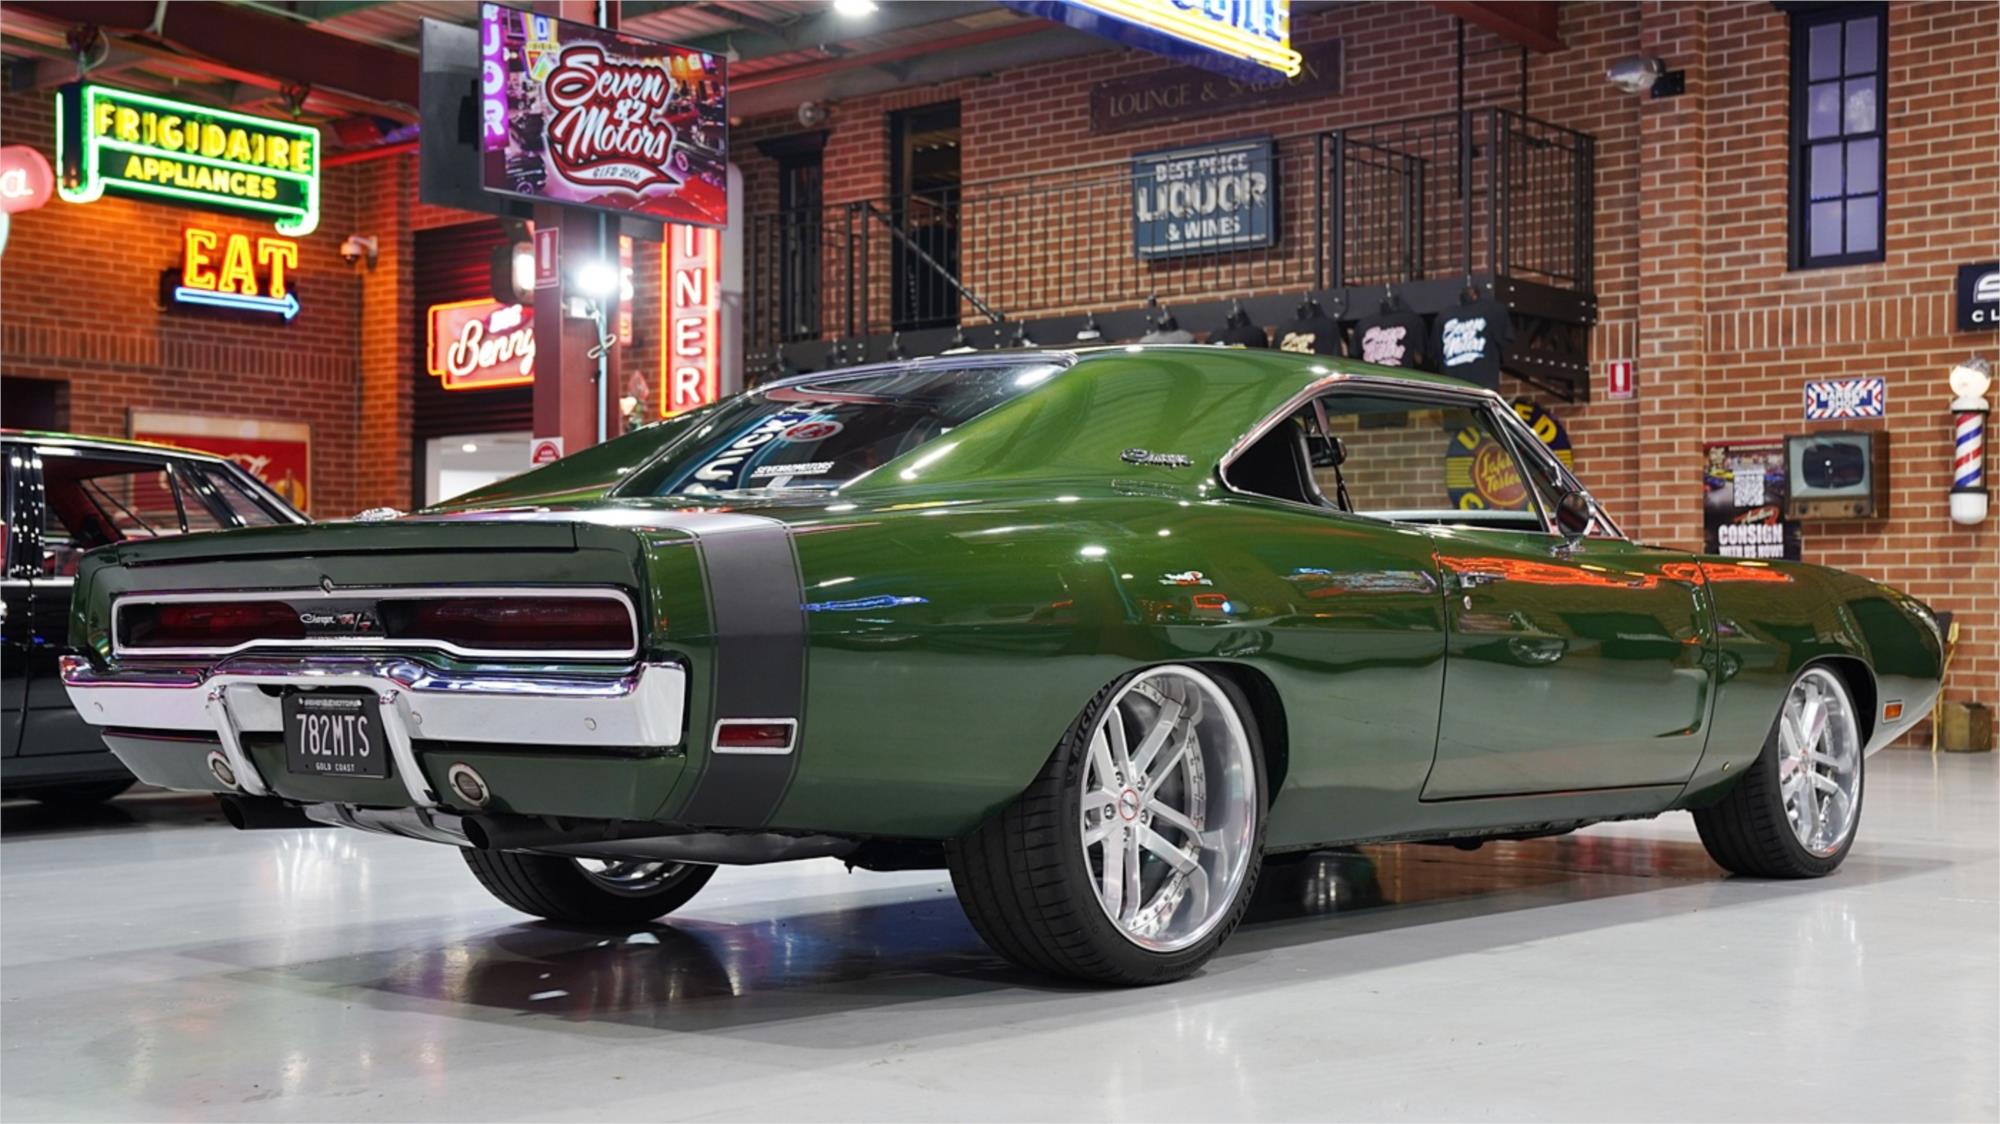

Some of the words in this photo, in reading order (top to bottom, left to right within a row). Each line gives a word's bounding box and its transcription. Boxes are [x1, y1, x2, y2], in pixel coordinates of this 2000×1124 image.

[552, 54, 665, 107] Seven
[1109, 83, 1192, 118] LOUNGE
[1201, 82, 1217, 101] &
[614, 99, 647, 123] 82
[94, 101, 312, 174] FRIGIDAIRE
[554, 106, 667, 160] Motors
[124, 155, 277, 199] APPLIANCES
[1155, 160, 1197, 182] BEST
[1199, 153, 1248, 174] PRICE
[1137, 172, 1267, 222] LIQUOR
[1166, 223, 1180, 241] &
[1184, 216, 1241, 239] WINES
[183, 228, 298, 298] EAT
[675, 224, 702, 405] INER
[1718, 523, 1783, 545] CONSIGN
[296, 714, 370, 757] 782MTS
[315, 762, 332, 771] GOLD
[335, 763, 355, 772] COAST
